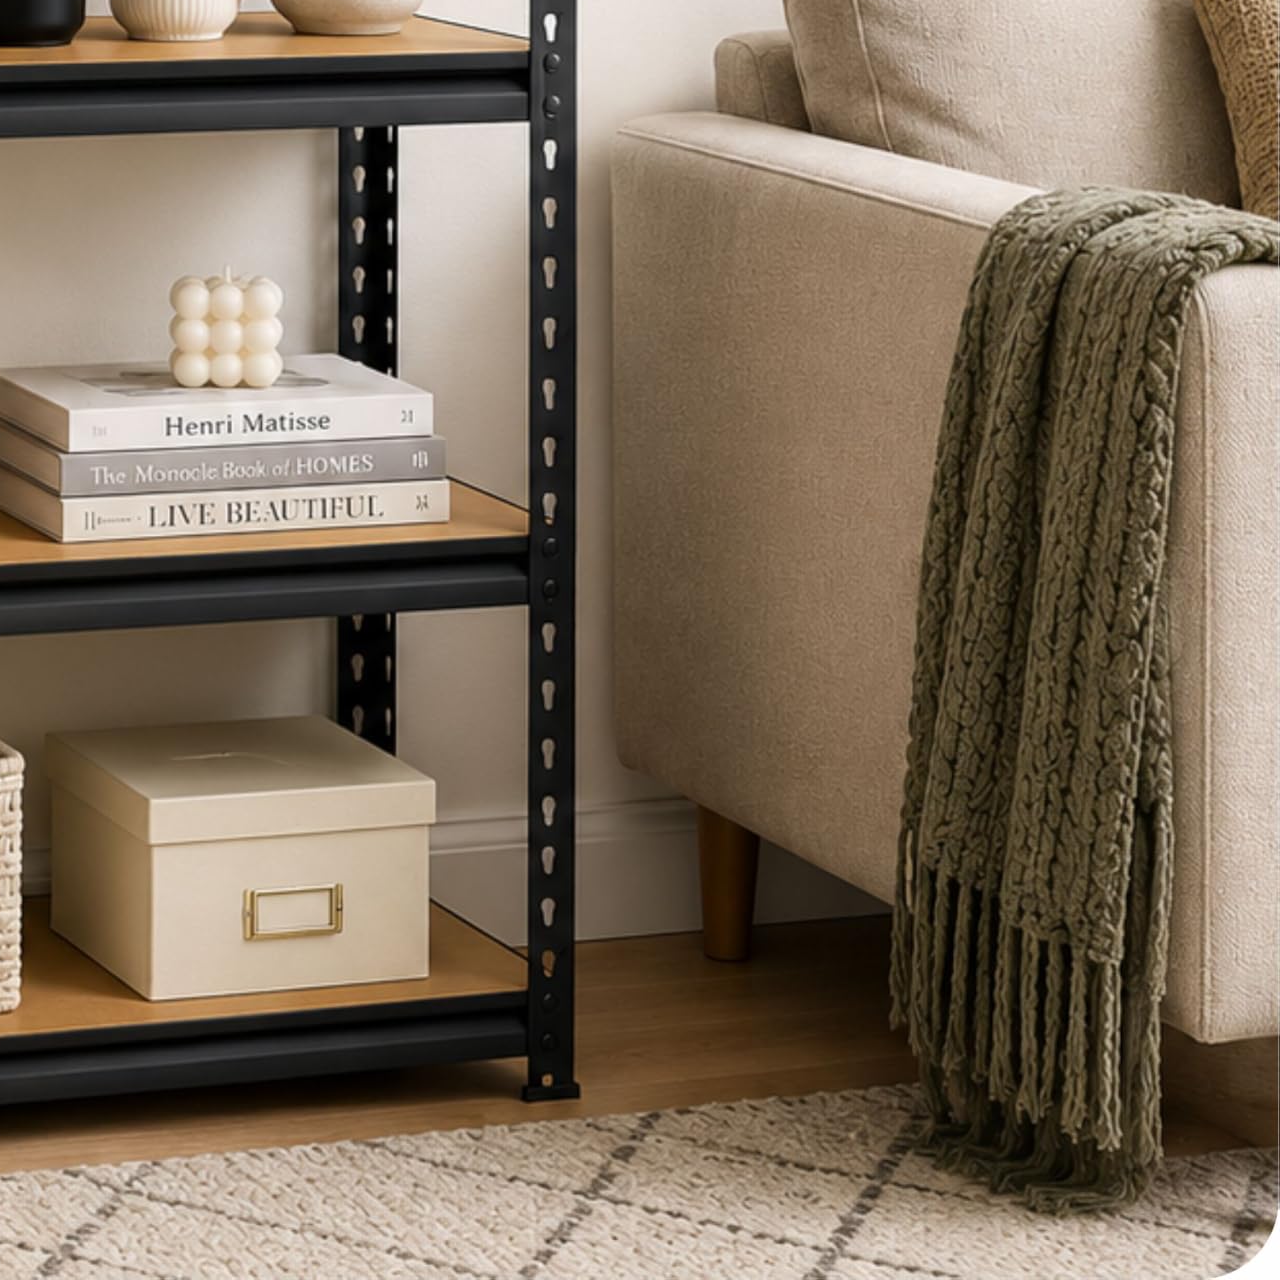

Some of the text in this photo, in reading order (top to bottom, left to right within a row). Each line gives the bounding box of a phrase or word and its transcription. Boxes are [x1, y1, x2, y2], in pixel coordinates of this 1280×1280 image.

[165, 412, 332, 437] Henri Matisse
[90, 465, 128, 485] The
[222, 459, 266, 480] Book
[271, 456, 290, 477] of
[296, 454, 375, 476] HOMES
[148, 503, 217, 528] LIVE
[226, 494, 386, 525] BEAUTIFUL
